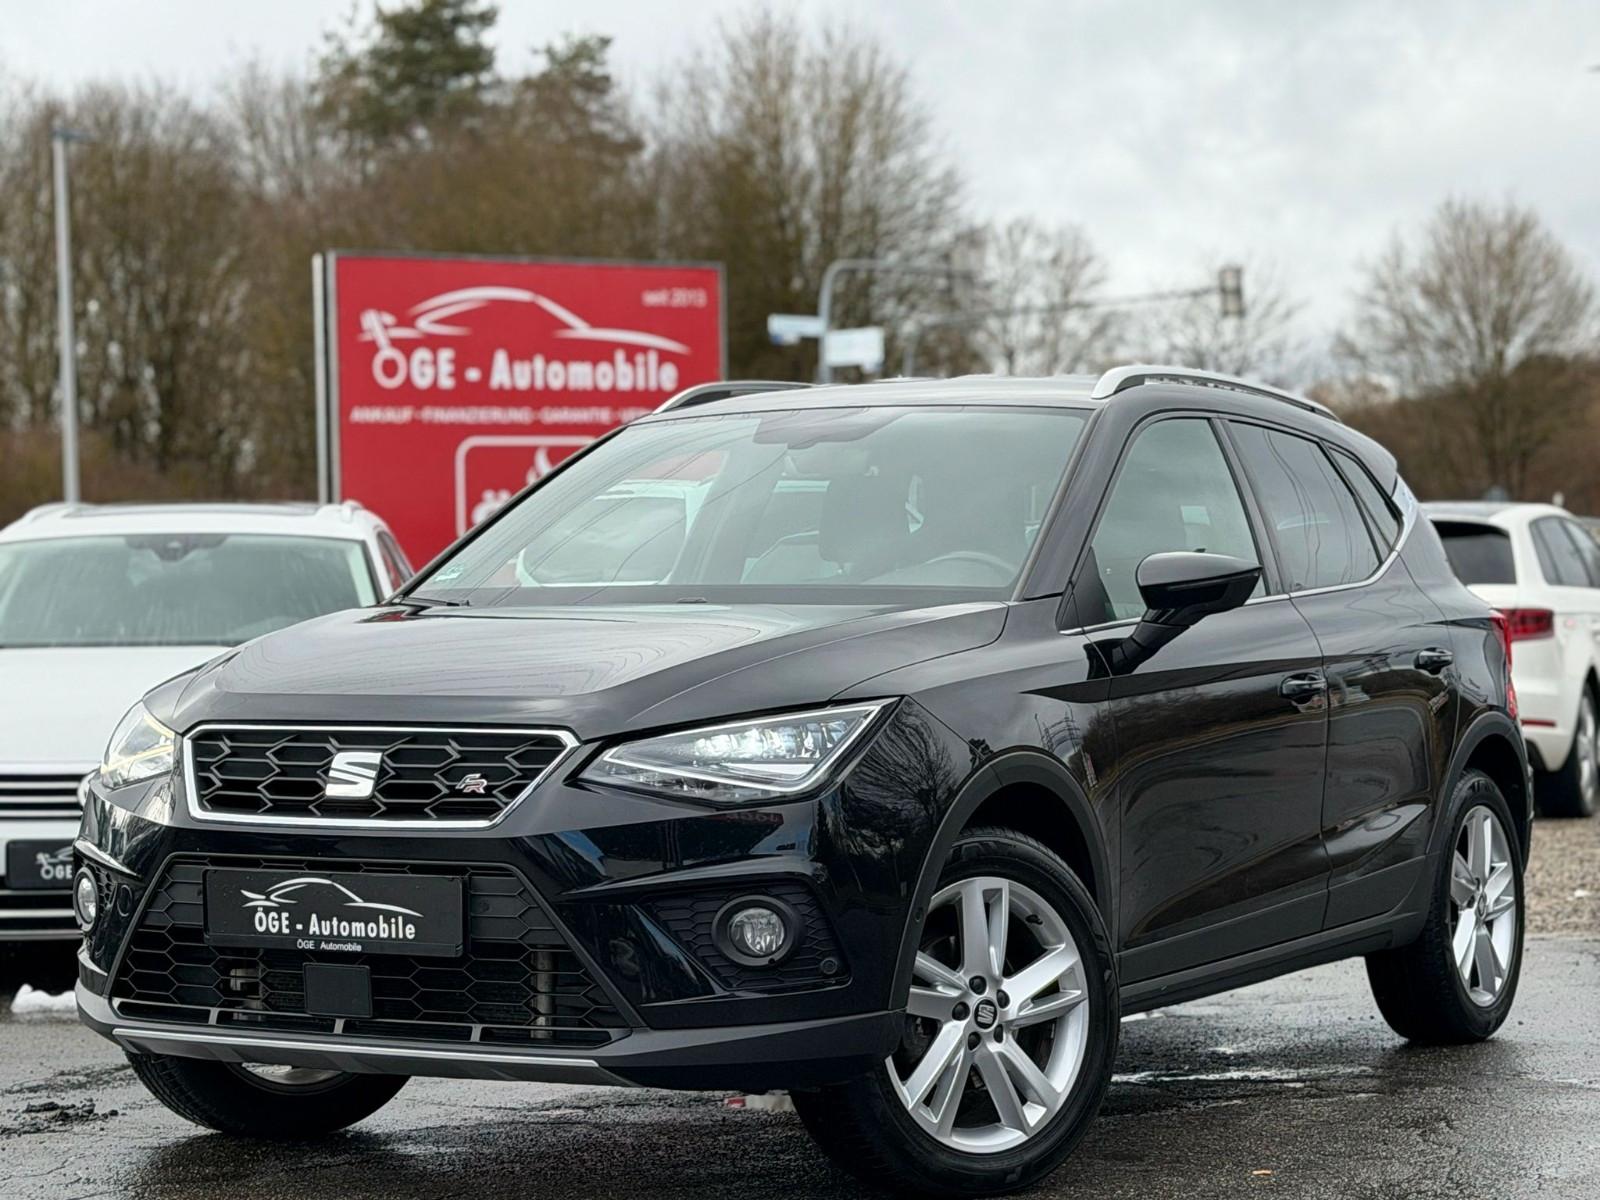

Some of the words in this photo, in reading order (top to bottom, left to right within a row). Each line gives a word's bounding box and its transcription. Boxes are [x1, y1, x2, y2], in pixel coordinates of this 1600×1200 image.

[489, 348, 679, 392] Automobile
[254, 906, 291, 934] ÖGE
[308, 913, 416, 940] Automobile
[296, 938, 316, 950] ÖGE
[320, 941, 362, 952] Automobile
